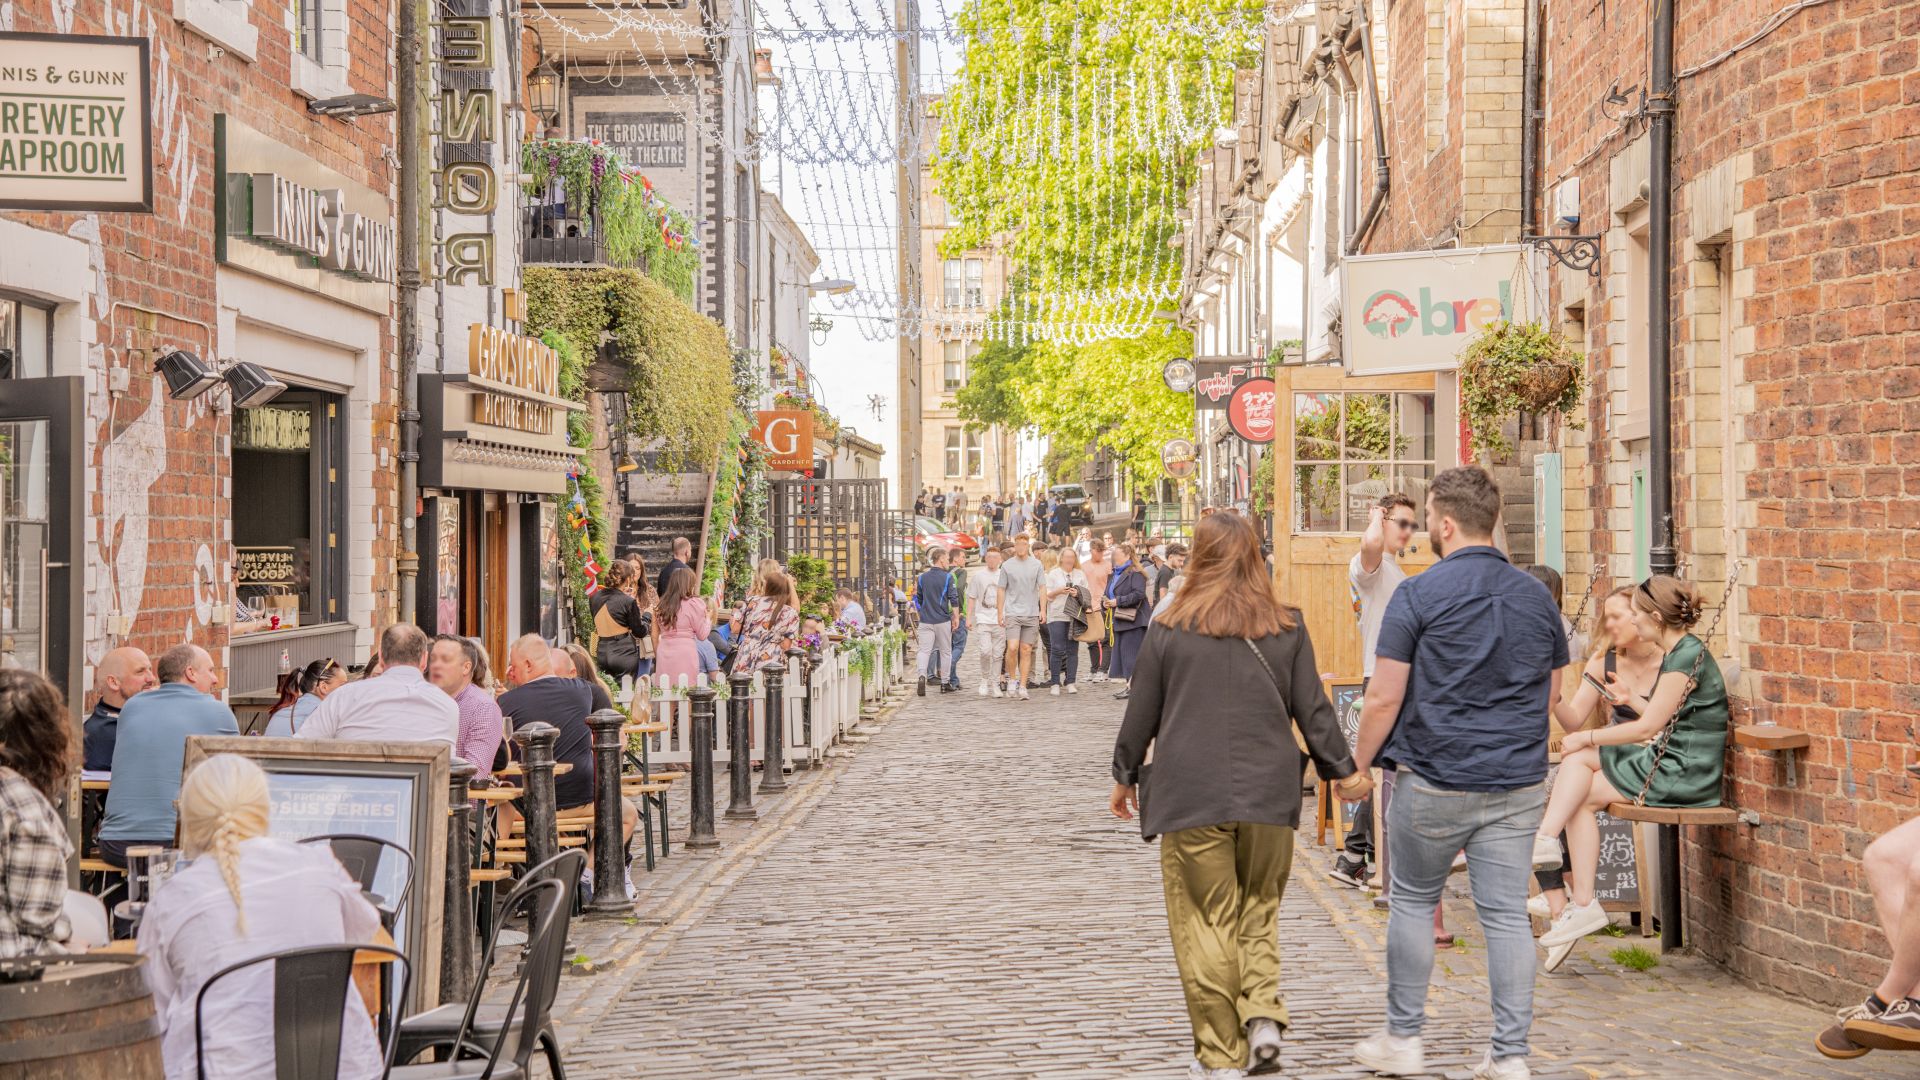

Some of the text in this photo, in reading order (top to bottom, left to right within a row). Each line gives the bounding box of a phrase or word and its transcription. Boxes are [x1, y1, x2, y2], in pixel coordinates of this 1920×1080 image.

[1, 66, 125, 86] NIS & GUNN
[2, 102, 125, 138] REWERY
[587, 122, 684, 143] THE GROSVENOR
[0, 139, 125, 175] APROOM
[636, 146, 684, 164] THEATRE
[273, 173, 397, 285] INNIS & GUNN
[484, 392, 521, 430] PICTURE
[764, 417, 801, 455] G
[323, 802, 396, 817] SERIES
